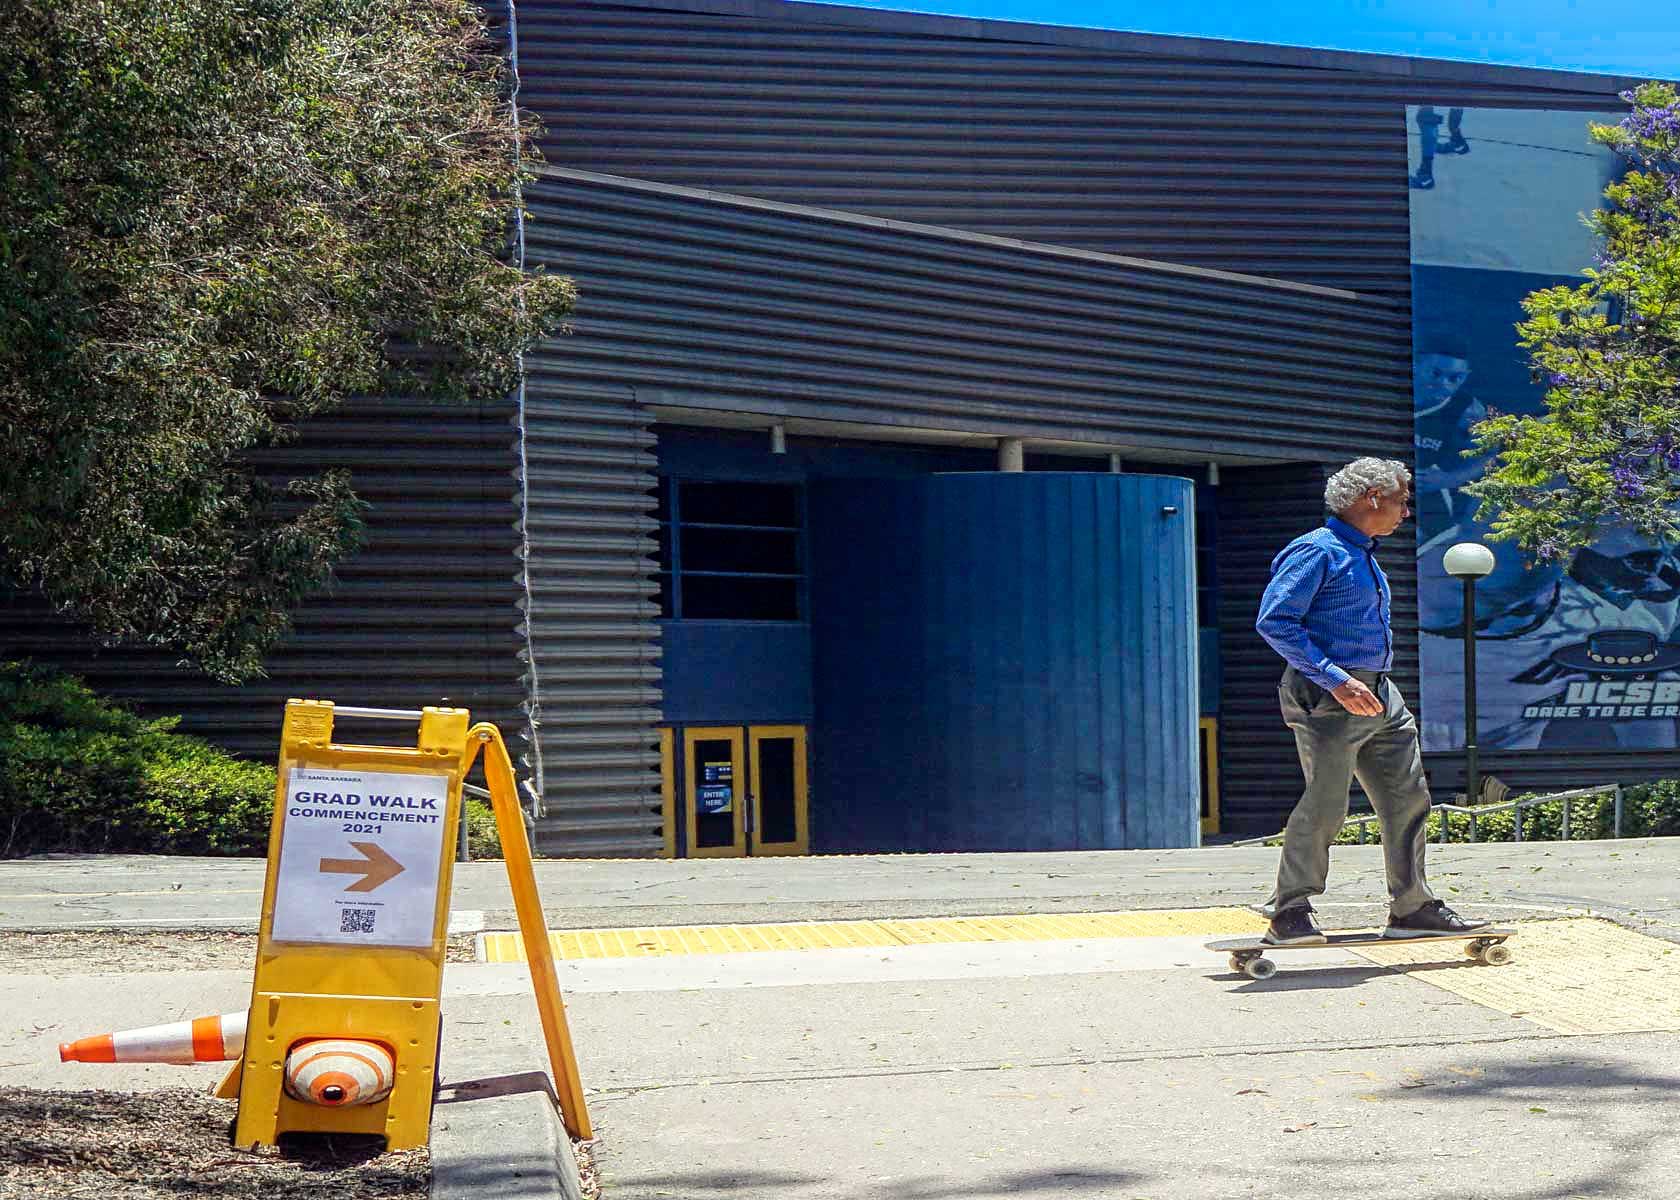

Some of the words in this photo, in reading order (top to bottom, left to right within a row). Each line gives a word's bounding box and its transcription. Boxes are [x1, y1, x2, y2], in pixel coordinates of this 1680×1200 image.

[1524, 705, 1581, 717] DARE
[1586, 705, 1617, 717] TO
[1618, 705, 1647, 717] BE
[295, 791, 361, 805] GRAD
[369, 795, 437, 809] WALK
[289, 807, 439, 823] COMMENCEMENT
[343, 823, 382, 834] 2021
